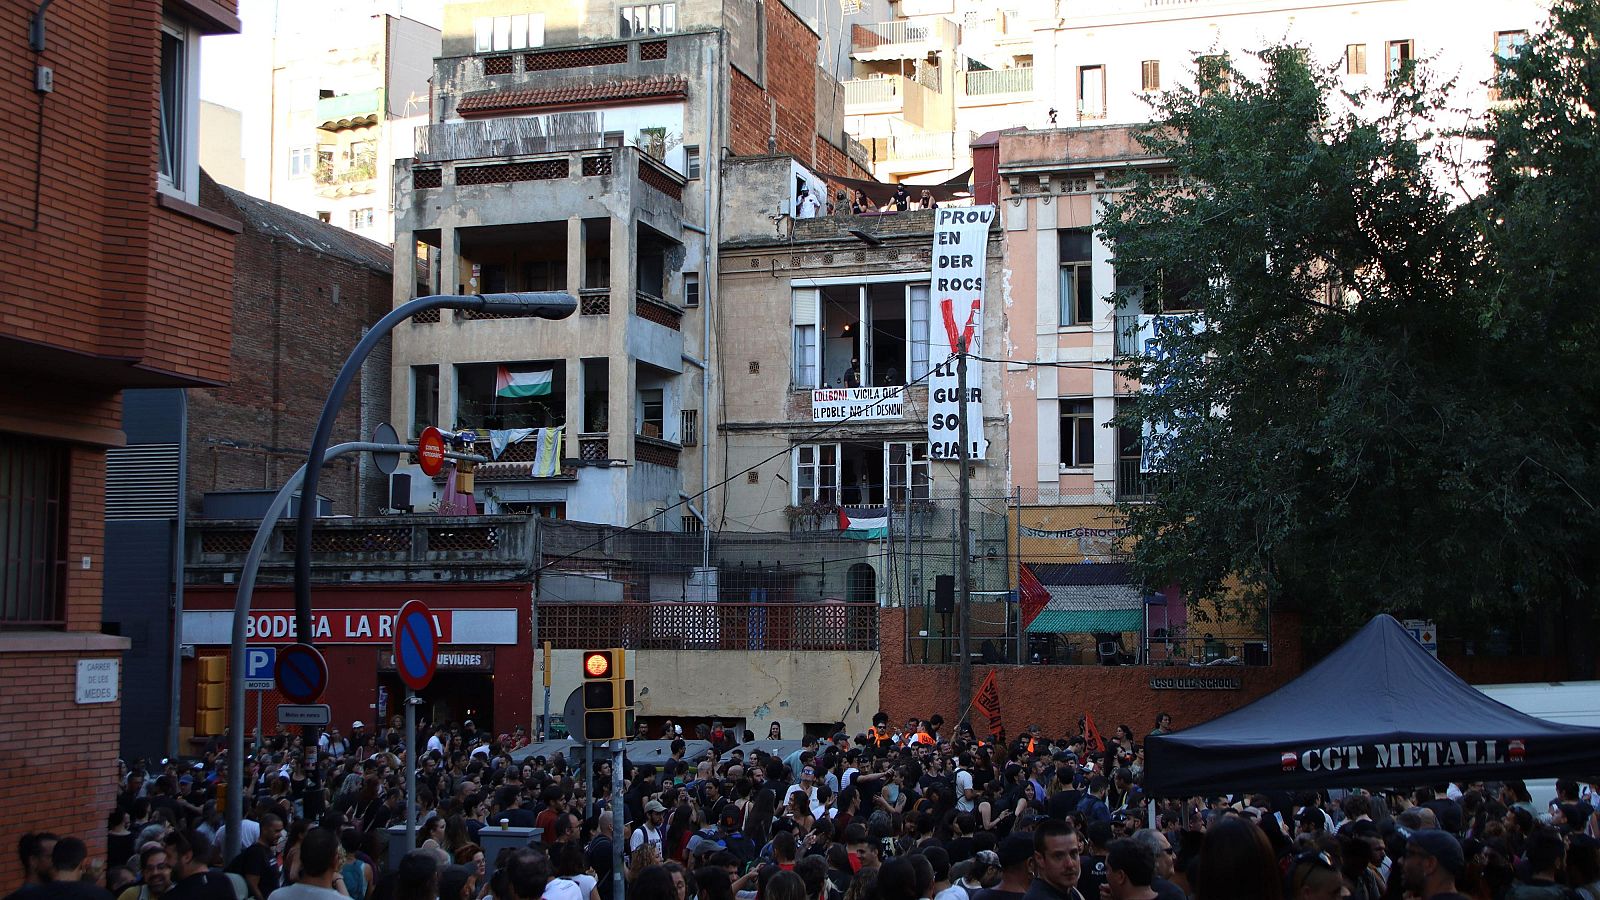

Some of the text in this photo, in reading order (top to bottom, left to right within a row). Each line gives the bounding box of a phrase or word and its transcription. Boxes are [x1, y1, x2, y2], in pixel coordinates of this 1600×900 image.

[939, 210, 992, 225] PROU
[938, 231, 961, 245] EN
[938, 254, 974, 269] DER
[937, 277, 982, 292] ROCS
[813, 408, 820, 419] EL
[821, 406, 846, 418] POBLE
[850, 405, 862, 417] NO
[931, 412, 960, 431] SO
[930, 441, 979, 459] CIA!
[1055, 529, 1073, 538] THE
[345, 614, 372, 638] LA
[87, 662, 111, 671] CARRER
[249, 650, 269, 676] P
[436, 654, 482, 666] UEVIURES
[88, 675, 109, 684] DE LES
[1154, 678, 1236, 689] CSO OLD SCHOOL
[84, 688, 111, 699] MEDES
[1302, 740, 1504, 772] CGT METALL
